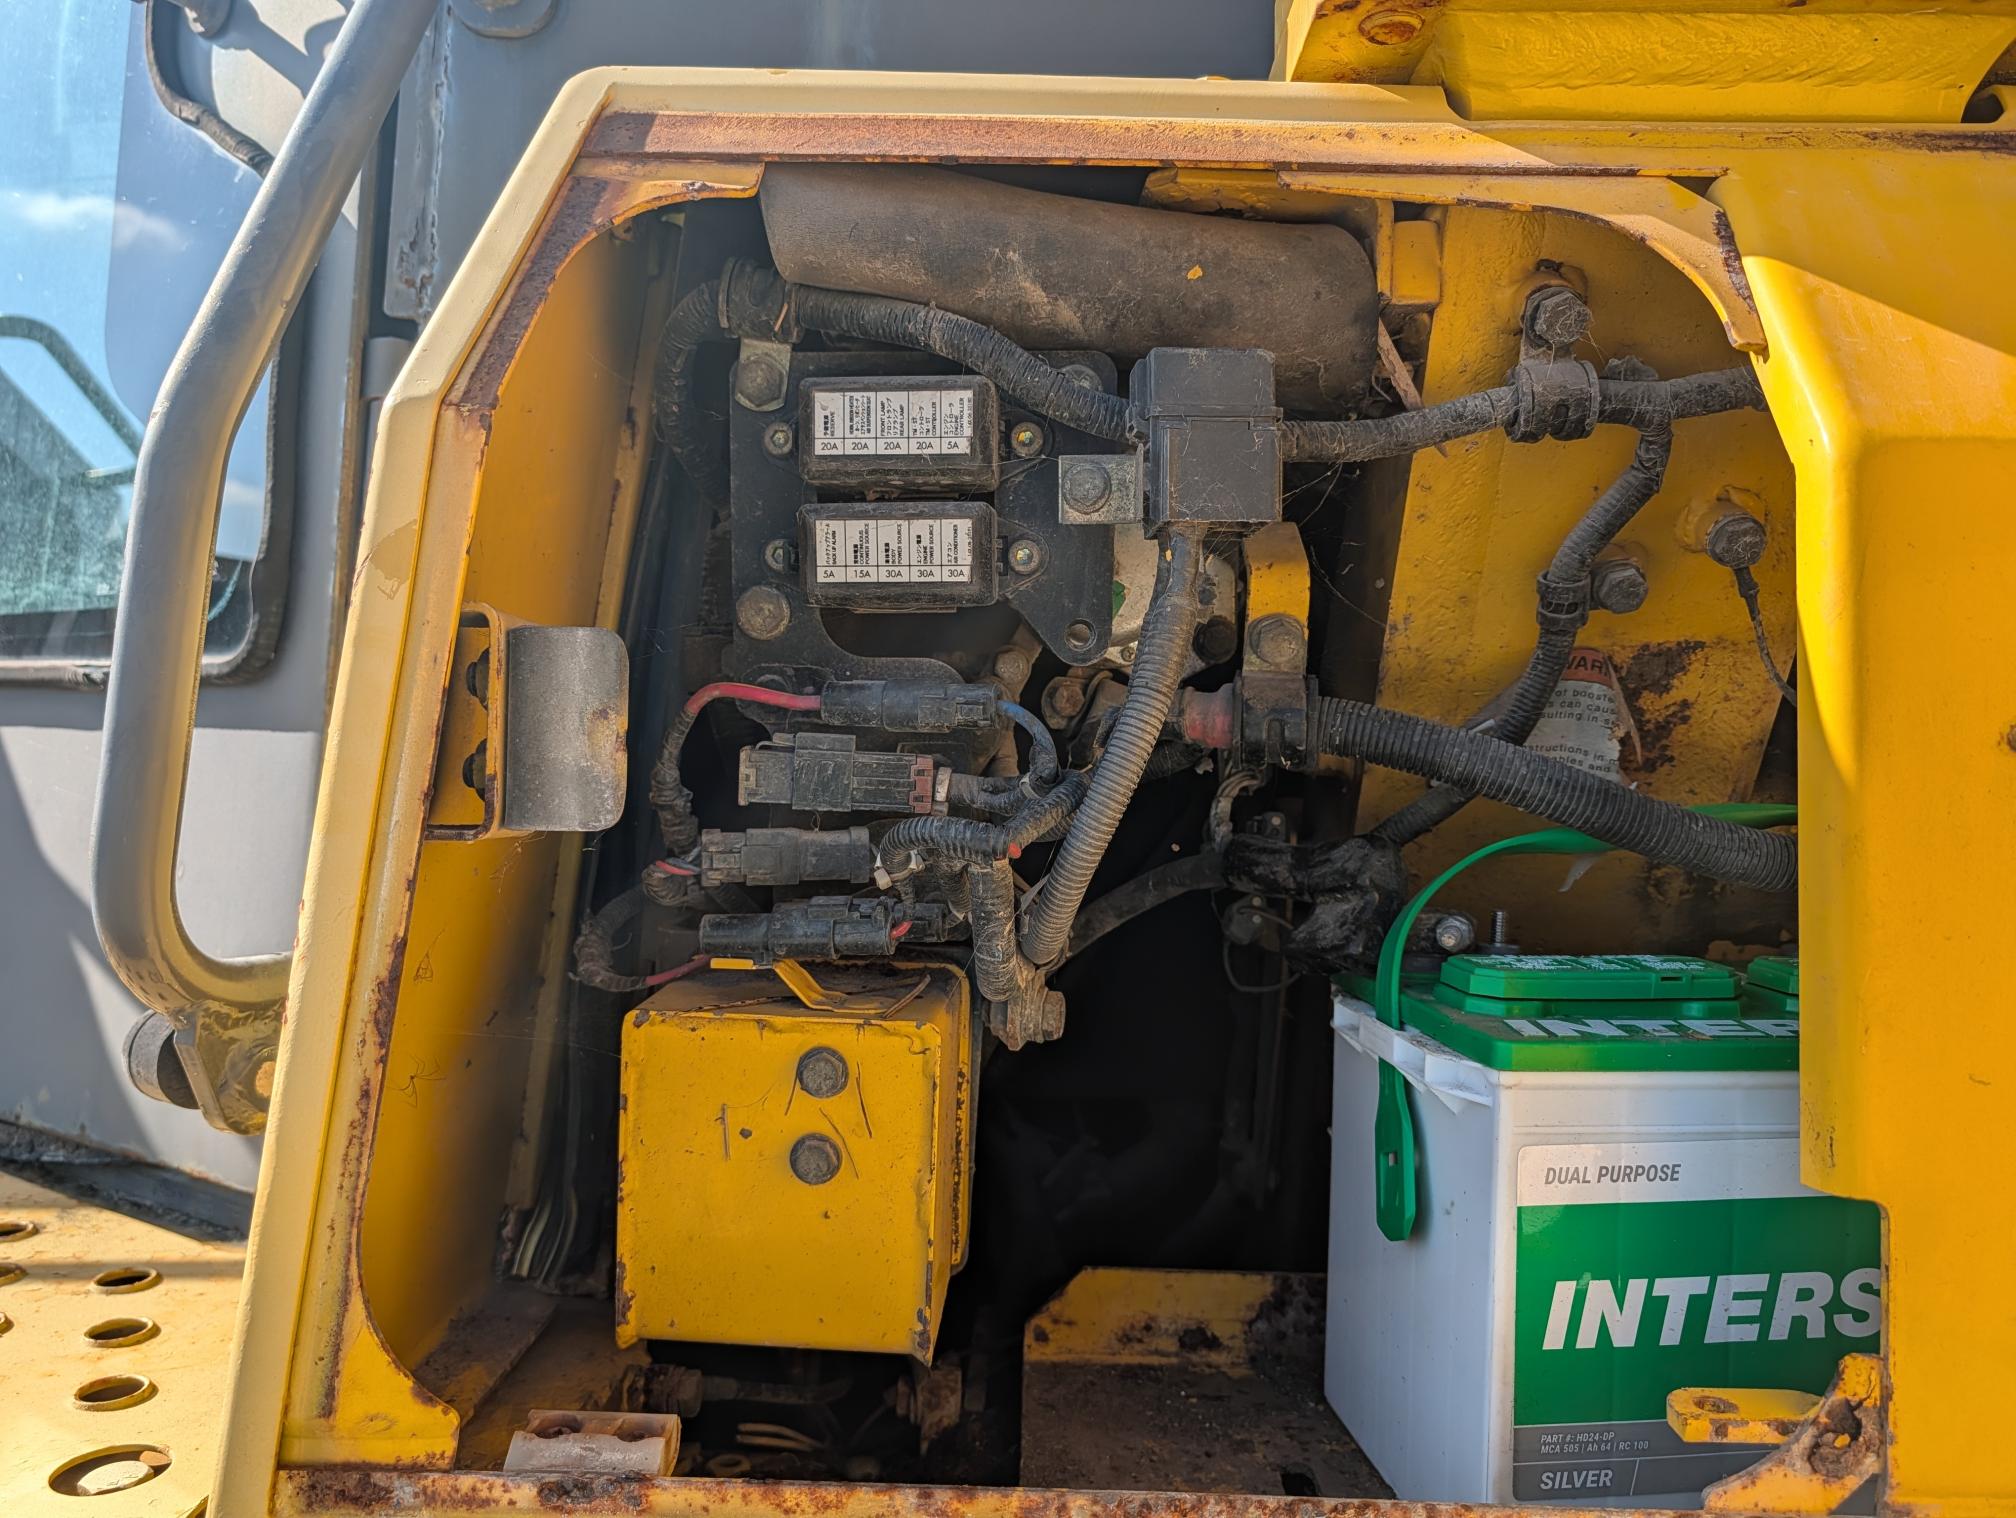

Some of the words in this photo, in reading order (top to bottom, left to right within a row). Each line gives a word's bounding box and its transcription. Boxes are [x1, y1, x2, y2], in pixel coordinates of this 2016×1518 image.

[821, 442, 838, 451] 20A
[851, 442, 869, 451] 20A
[884, 442, 902, 450] 20A
[916, 442, 934, 450] 20A
[946, 442, 959, 450] 5A
[823, 570, 835, 579] 5A
[854, 570, 871, 578] 15A
[885, 569, 903, 578] 30A
[917, 569, 935, 578] 30A
[947, 569, 965, 577] 30A
[1560, 700, 1581, 708] can
[1588, 715, 1598, 723] in
[1588, 764, 1611, 772] and
[1544, 1166, 1591, 1185] DUAL
[1597, 1163, 1682, 1183] PURPOSE
[1542, 1267, 1882, 1350] INTERS
[1541, 1434, 1563, 1444] PART
[1565, 1434, 1574, 1443] #:
[1576, 1432, 1615, 1442] HD24-DP
[1540, 1444, 1560, 1454] MCA
[1563, 1443, 1579, 1453] 505
[1587, 1442, 1598, 1452] Ah
[1600, 1442, 1611, 1452] 64
[1619, 1441, 1630, 1450] RC
[1634, 1440, 1649, 1450] 100
[1540, 1469, 1613, 1490] SILVER
